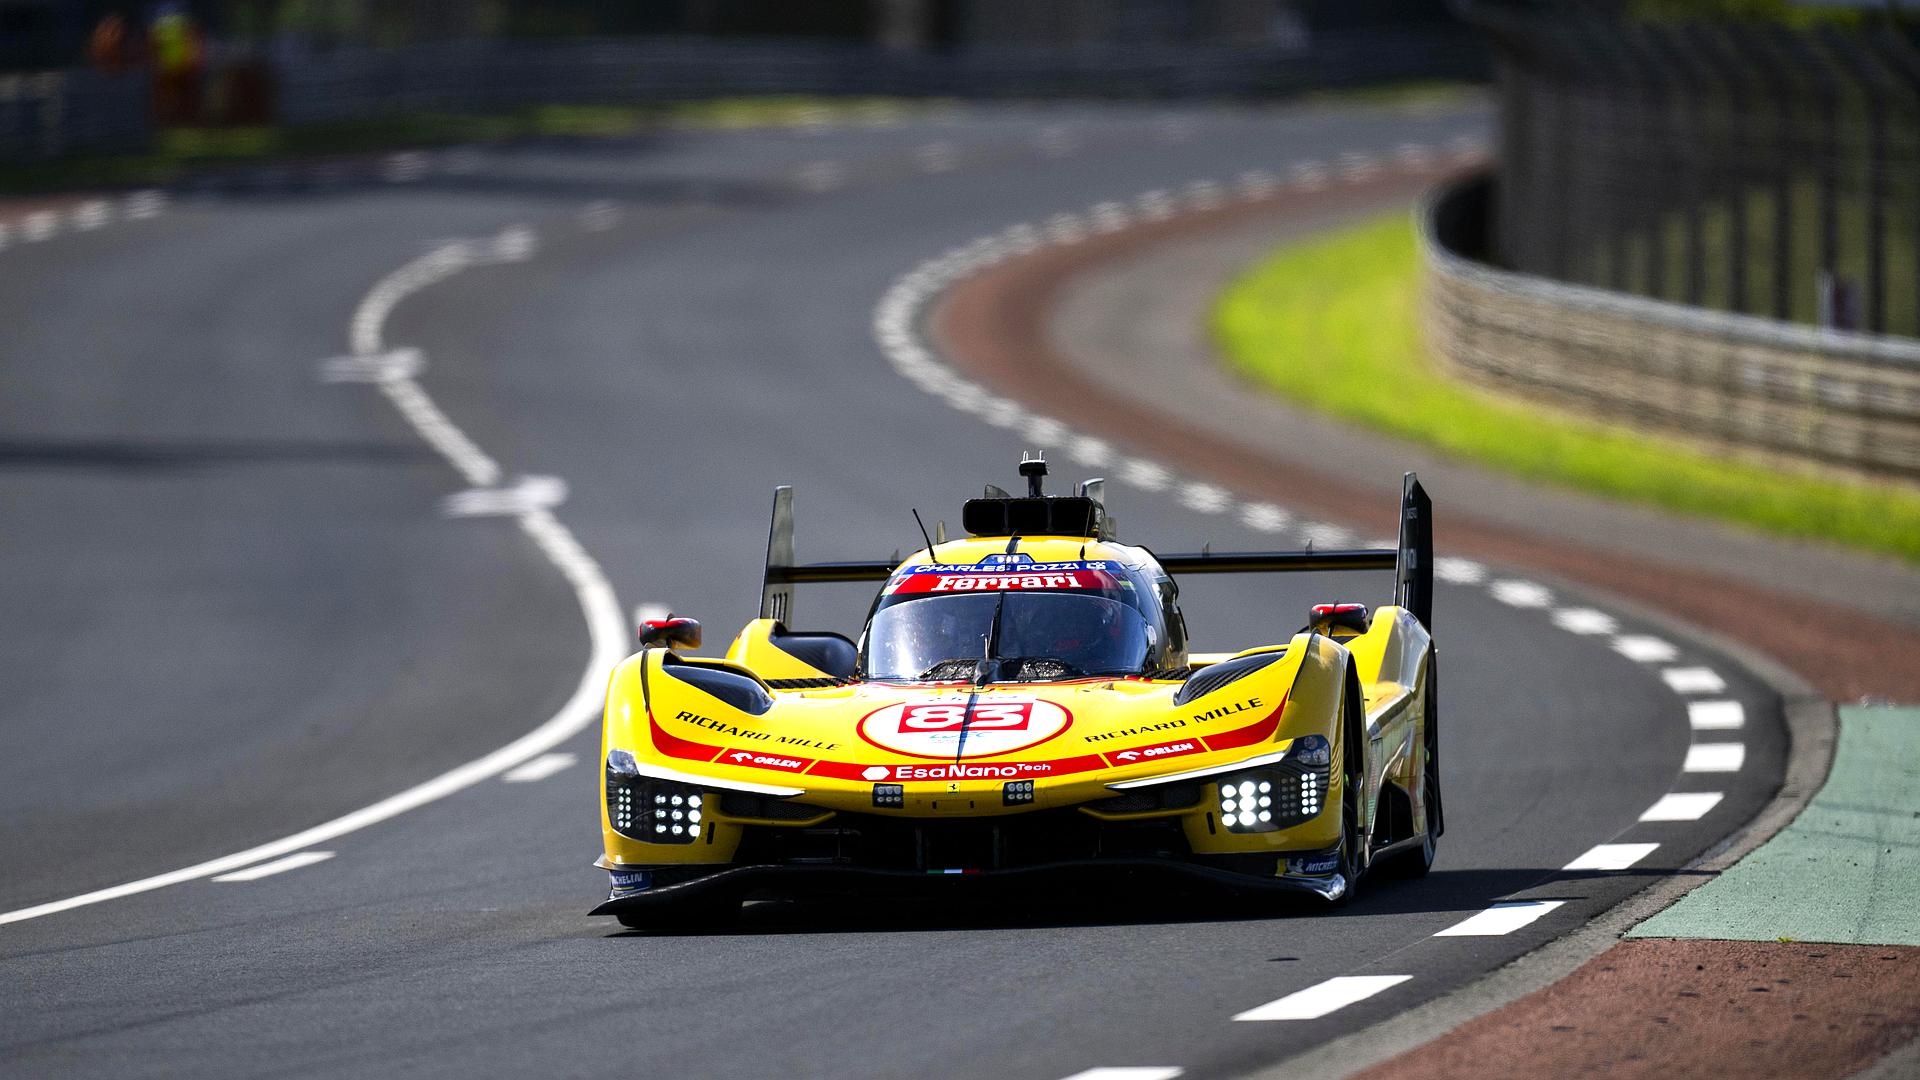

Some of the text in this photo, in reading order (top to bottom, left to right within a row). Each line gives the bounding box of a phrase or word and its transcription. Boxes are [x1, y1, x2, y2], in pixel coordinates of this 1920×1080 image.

[914, 564, 1006, 573] CHARLES
[1016, 562, 1079, 572] POZZI
[931, 572, 1082, 592] Ferrari
[905, 704, 1024, 729] 83
[1085, 697, 1264, 743] RICHARD MILLE
[675, 710, 842, 751] RICHARD MILLE
[1144, 742, 1194, 757] ORLEN
[753, 756, 802, 768] ORLEN
